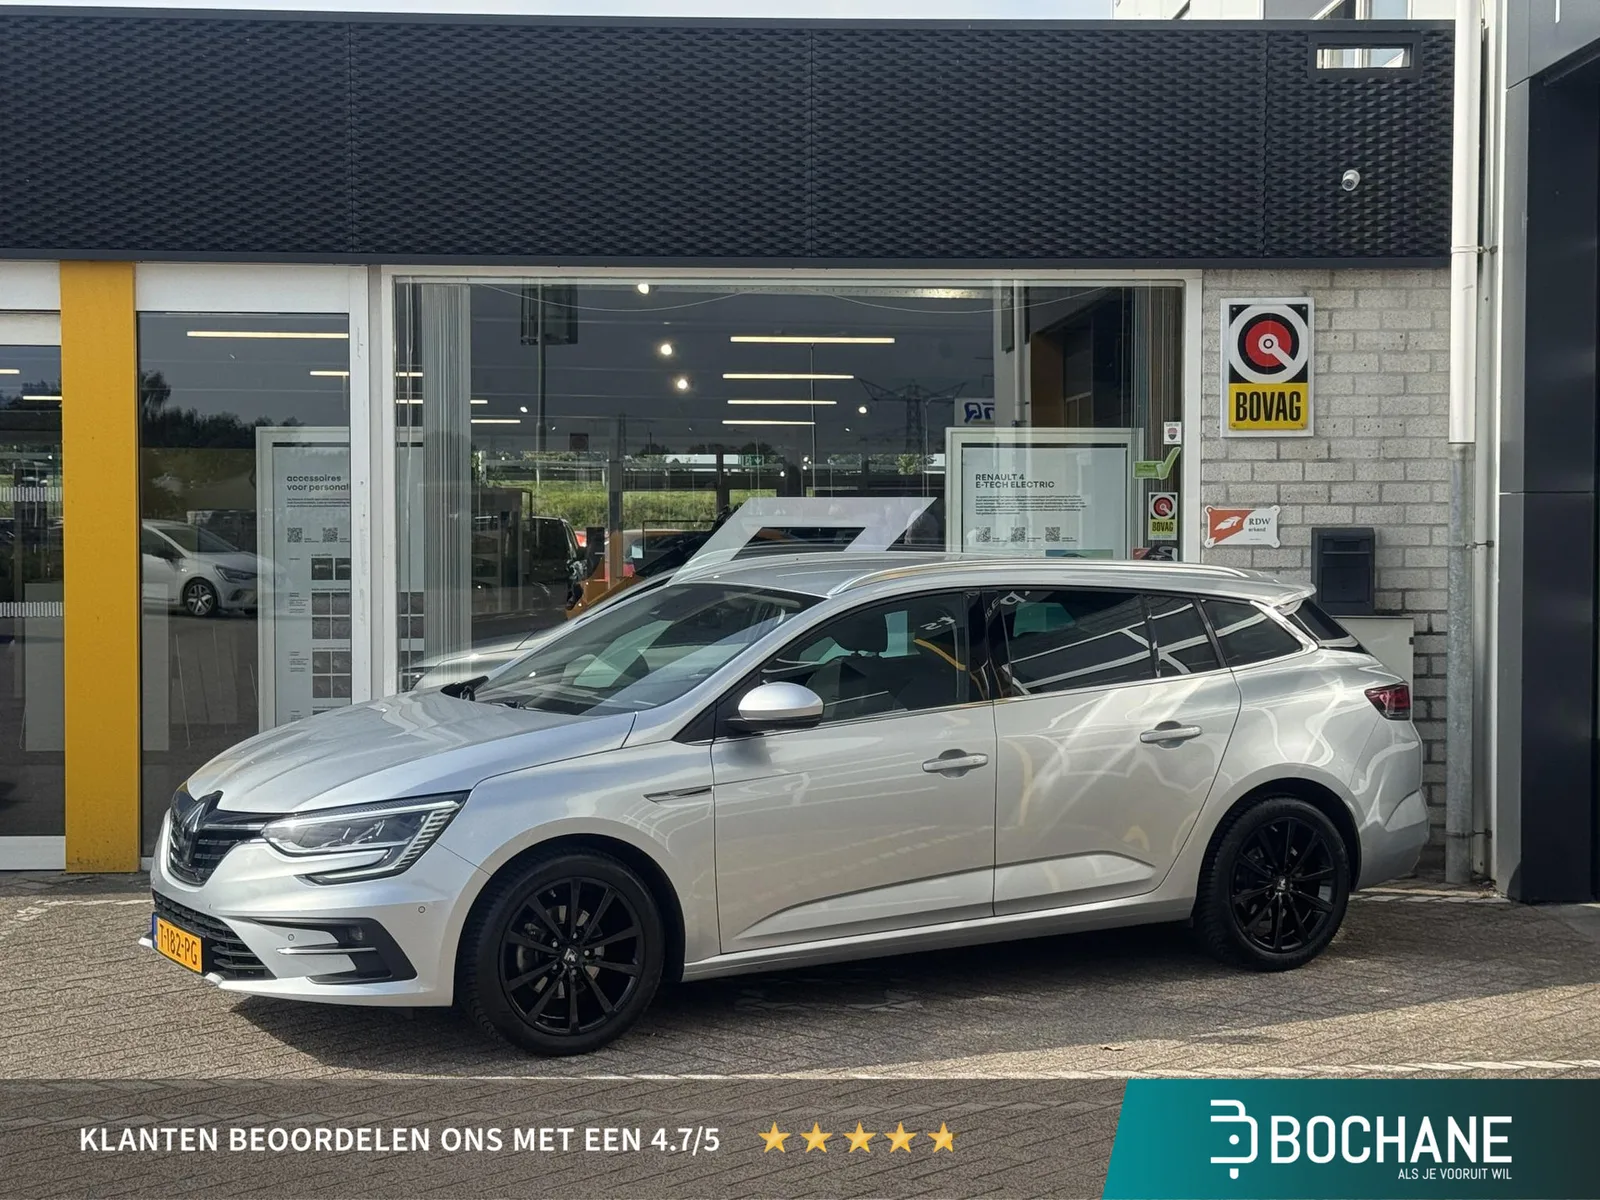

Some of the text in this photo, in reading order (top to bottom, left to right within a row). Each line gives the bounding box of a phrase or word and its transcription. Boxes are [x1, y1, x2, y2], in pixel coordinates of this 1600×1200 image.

[1235, 391, 1301, 422] BOVAG
[286, 474, 341, 482] accessoires
[975, 473, 1025, 481] RENAULT 4
[975, 481, 1055, 489] E-TECH ELECTRIC
[1248, 518, 1271, 526] RDW
[1151, 521, 1174, 532] BOVAG
[159, 923, 198, 966] T-182-PG
